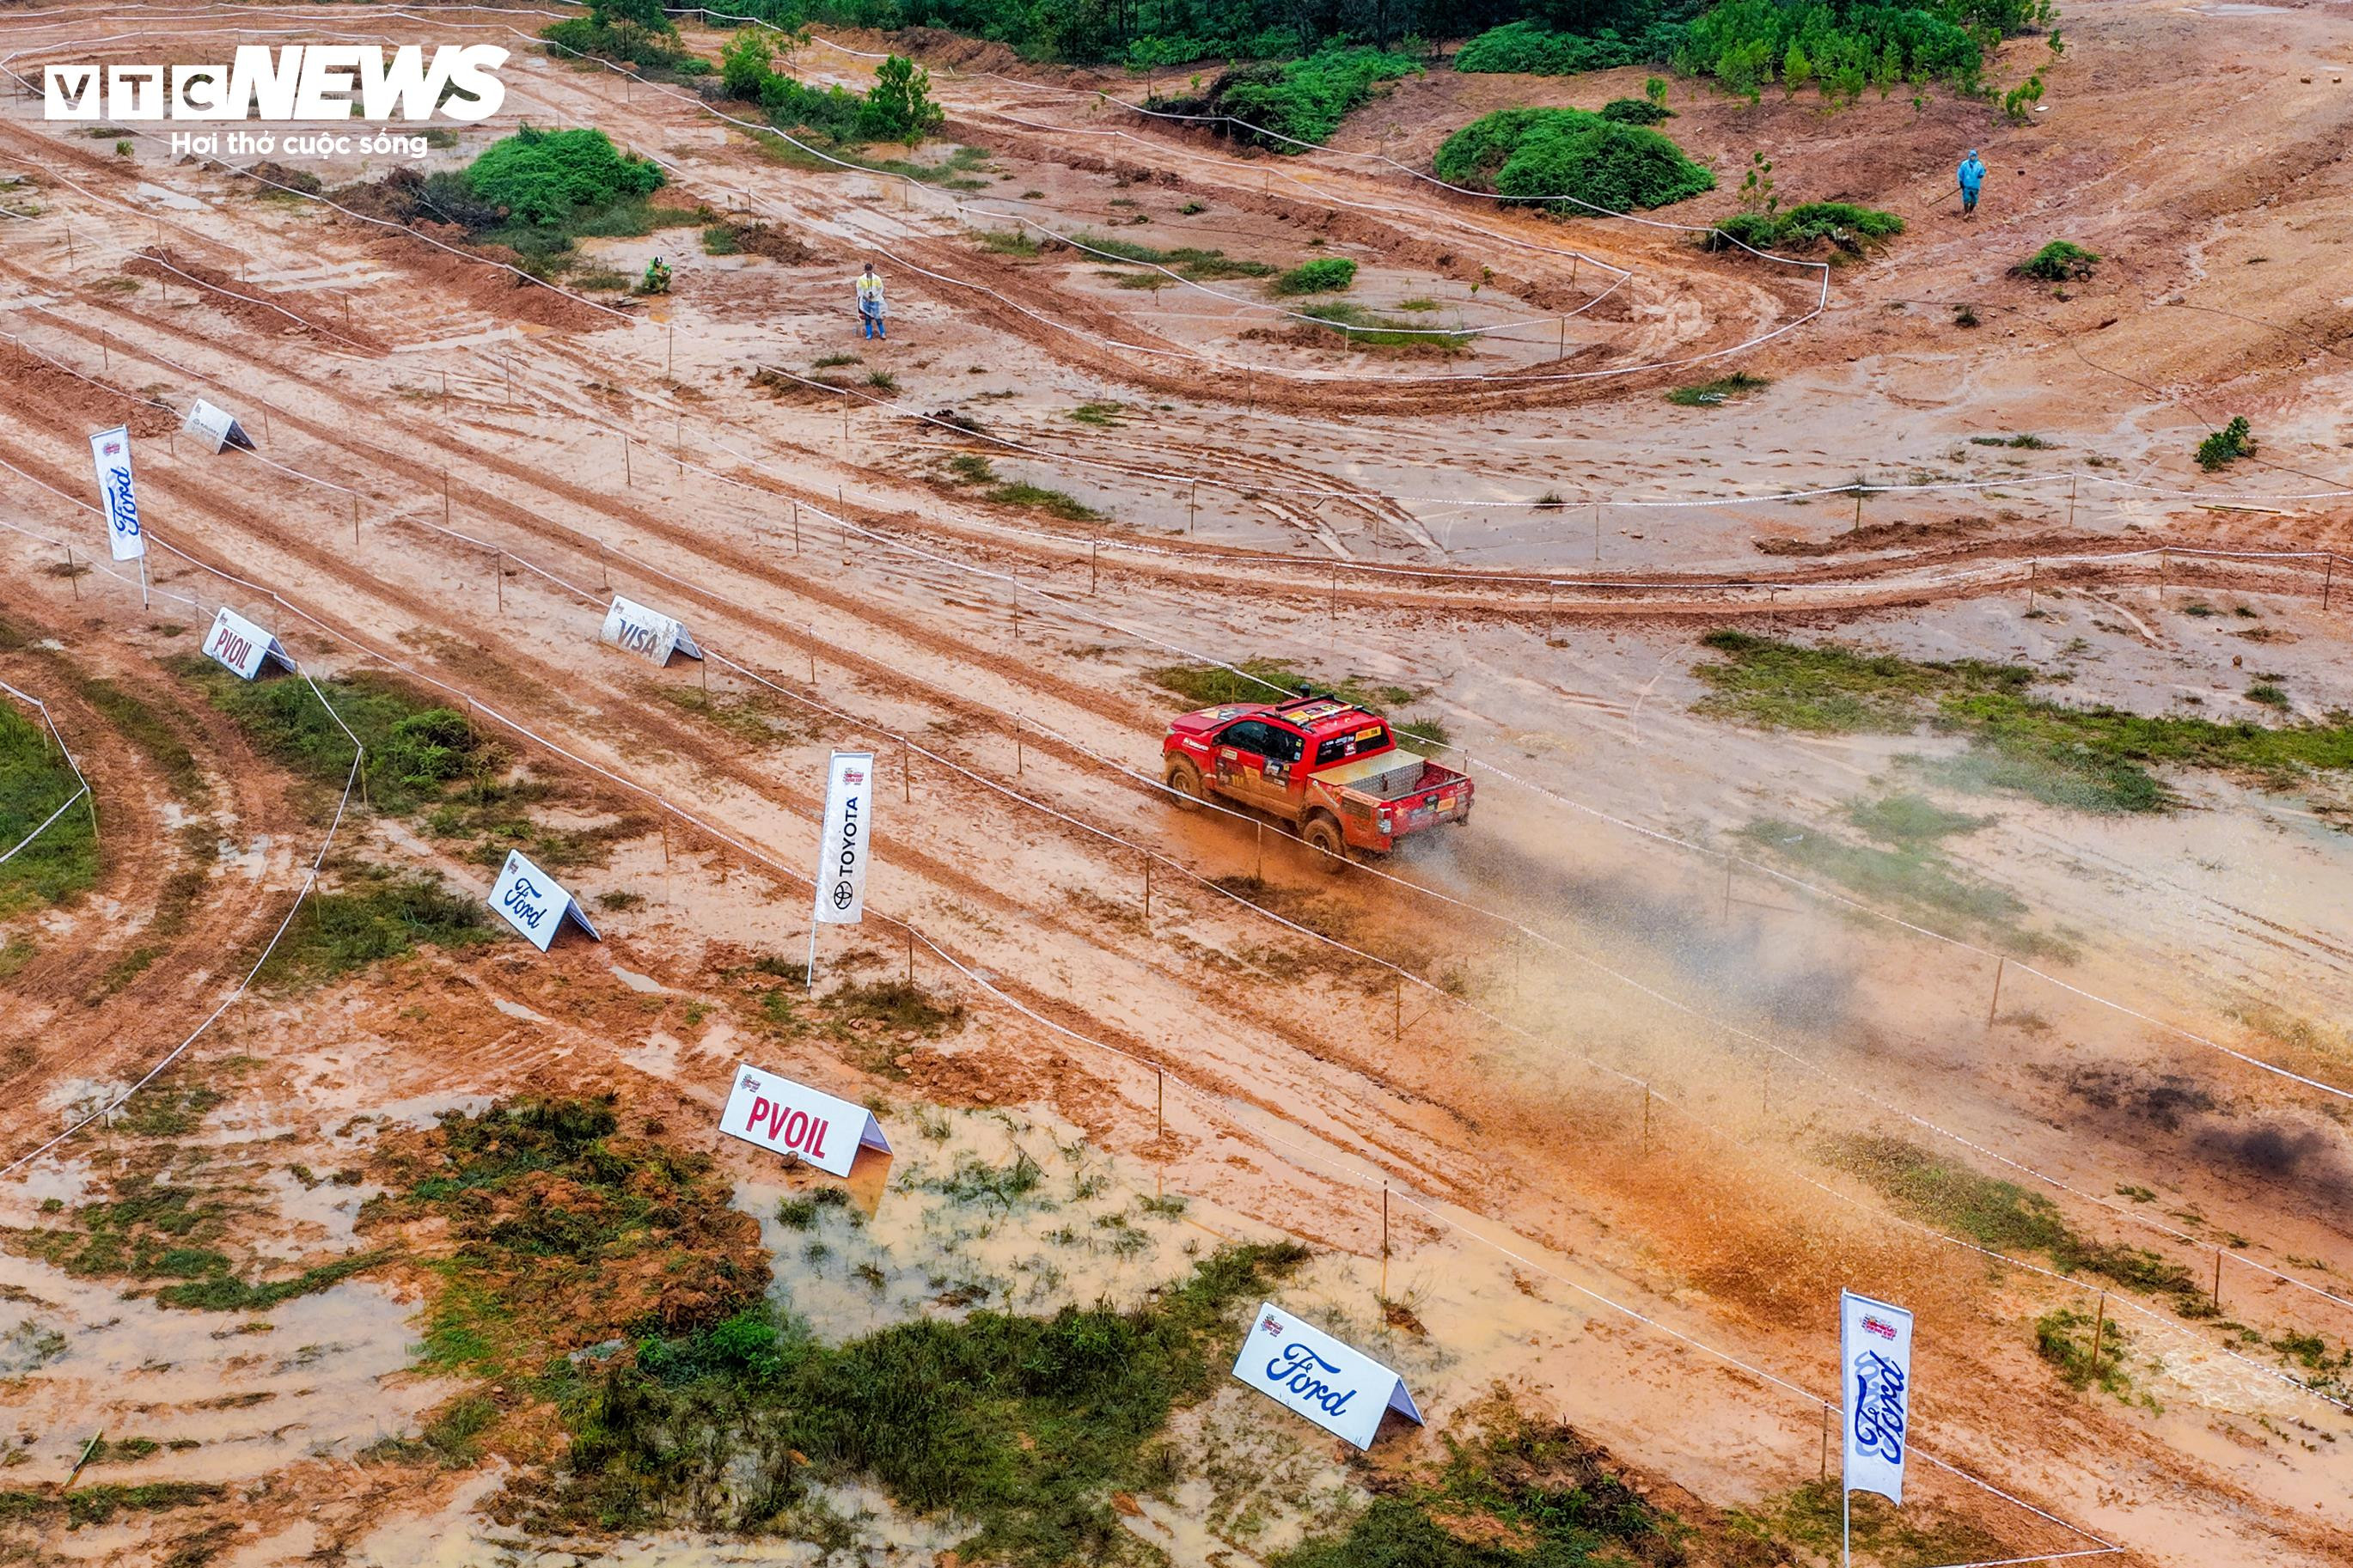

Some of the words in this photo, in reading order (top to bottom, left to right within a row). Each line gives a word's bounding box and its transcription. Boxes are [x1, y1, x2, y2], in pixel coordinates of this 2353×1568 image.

[108, 467, 140, 535] Ford
[212, 628, 252, 669] PVOIL
[617, 618, 660, 658] VISA
[840, 796, 858, 877] TOYOTA
[504, 877, 547, 929] Ford
[745, 1096, 829, 1159] PVOIL
[1266, 1343, 1357, 1416] Ford
[1854, 1350, 1905, 1465] Ford
